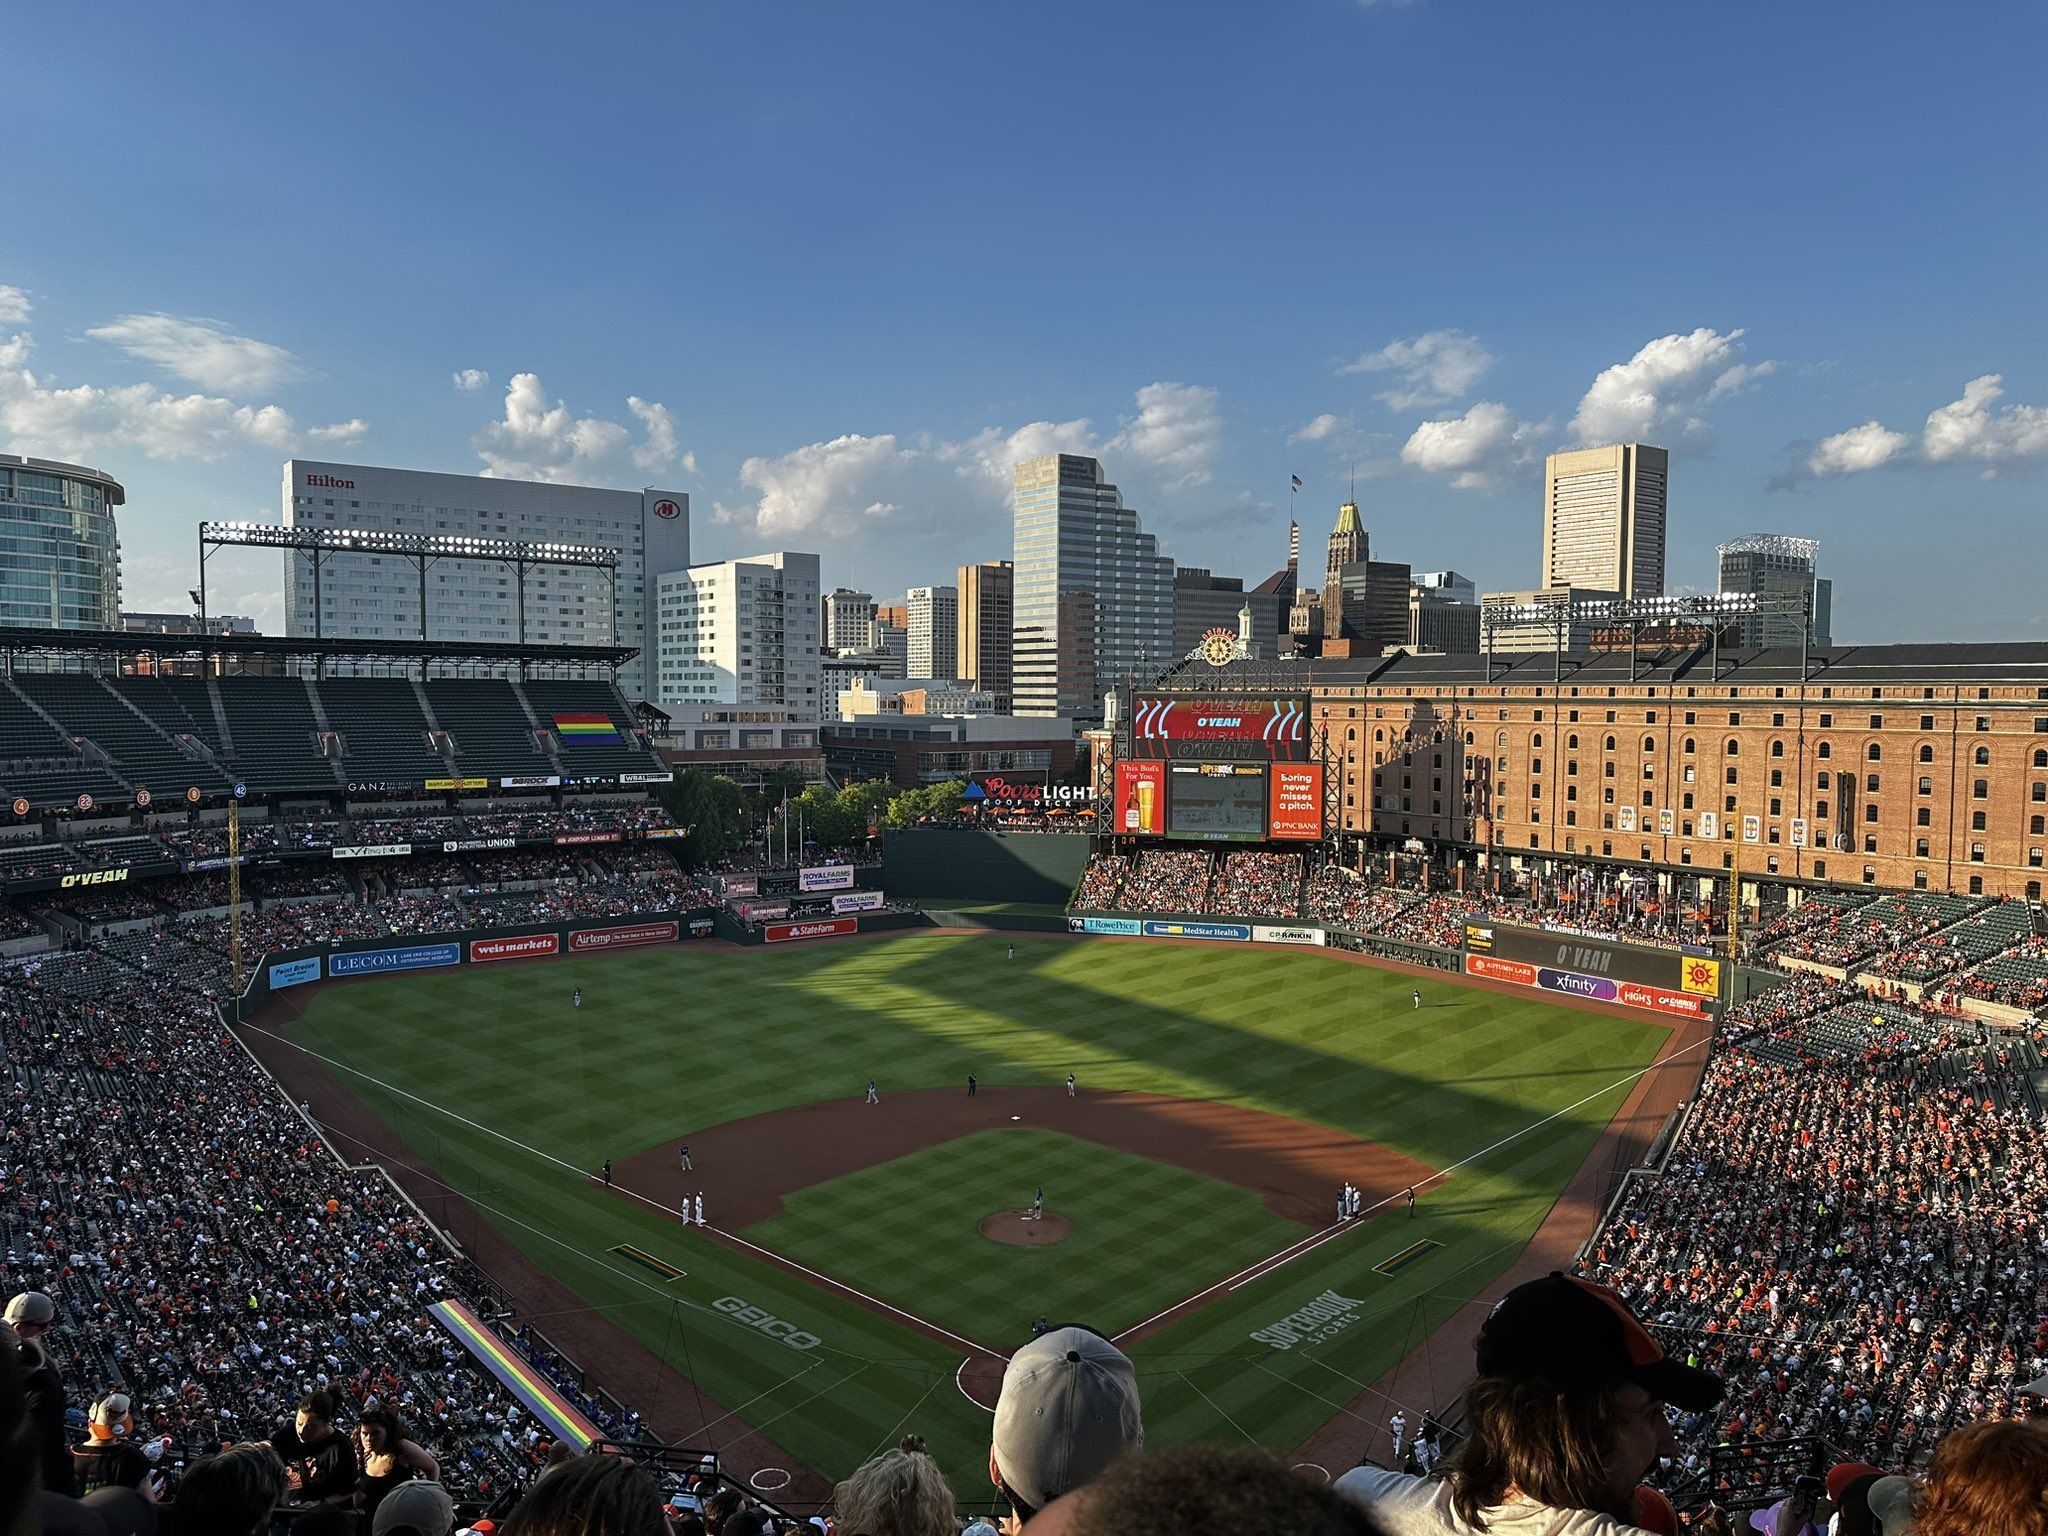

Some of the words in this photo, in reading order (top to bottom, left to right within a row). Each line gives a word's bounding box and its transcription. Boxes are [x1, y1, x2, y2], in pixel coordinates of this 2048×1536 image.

[306, 474, 355, 489] Hilton
[1281, 773, 1312, 783] Boring
[235, 786, 245, 795] 42
[348, 782, 385, 791] GANZ
[985, 778, 1040, 799] Coors
[1043, 785, 1097, 800] LIGHT
[139, 793, 149, 802] 33
[1280, 792, 1312, 800] misses
[80, 797, 91, 806] 22
[1288, 801, 1315, 811] pitch.
[487, 838, 515, 847] UNION
[61, 868, 128, 888] O'YEAH
[1184, 927, 1213, 935] MedStar
[1214, 928, 1239, 936] Health
[1488, 915, 1518, 926] Personal
[1519, 918, 1540, 930] Loans
[1545, 923, 1580, 936] MARINER
[1582, 928, 1617, 940] FINANCE
[1622, 935, 1656, 948] Personal
[1658, 941, 1682, 951] Loans
[577, 934, 611, 944] Airtemp
[478, 944, 504, 954] weis
[506, 940, 552, 951] markets
[1486, 963, 1513, 972] AUTUMN
[1556, 975, 1597, 994] xfinity
[1625, 991, 1652, 1006] HIGH'S
[1670, 998, 1697, 1007] CARROLL
[712, 1297, 822, 1350] GEICO
[1250, 1289, 1366, 1350] SUPERBOOK
[1307, 1312, 1361, 1344] SPORTS
